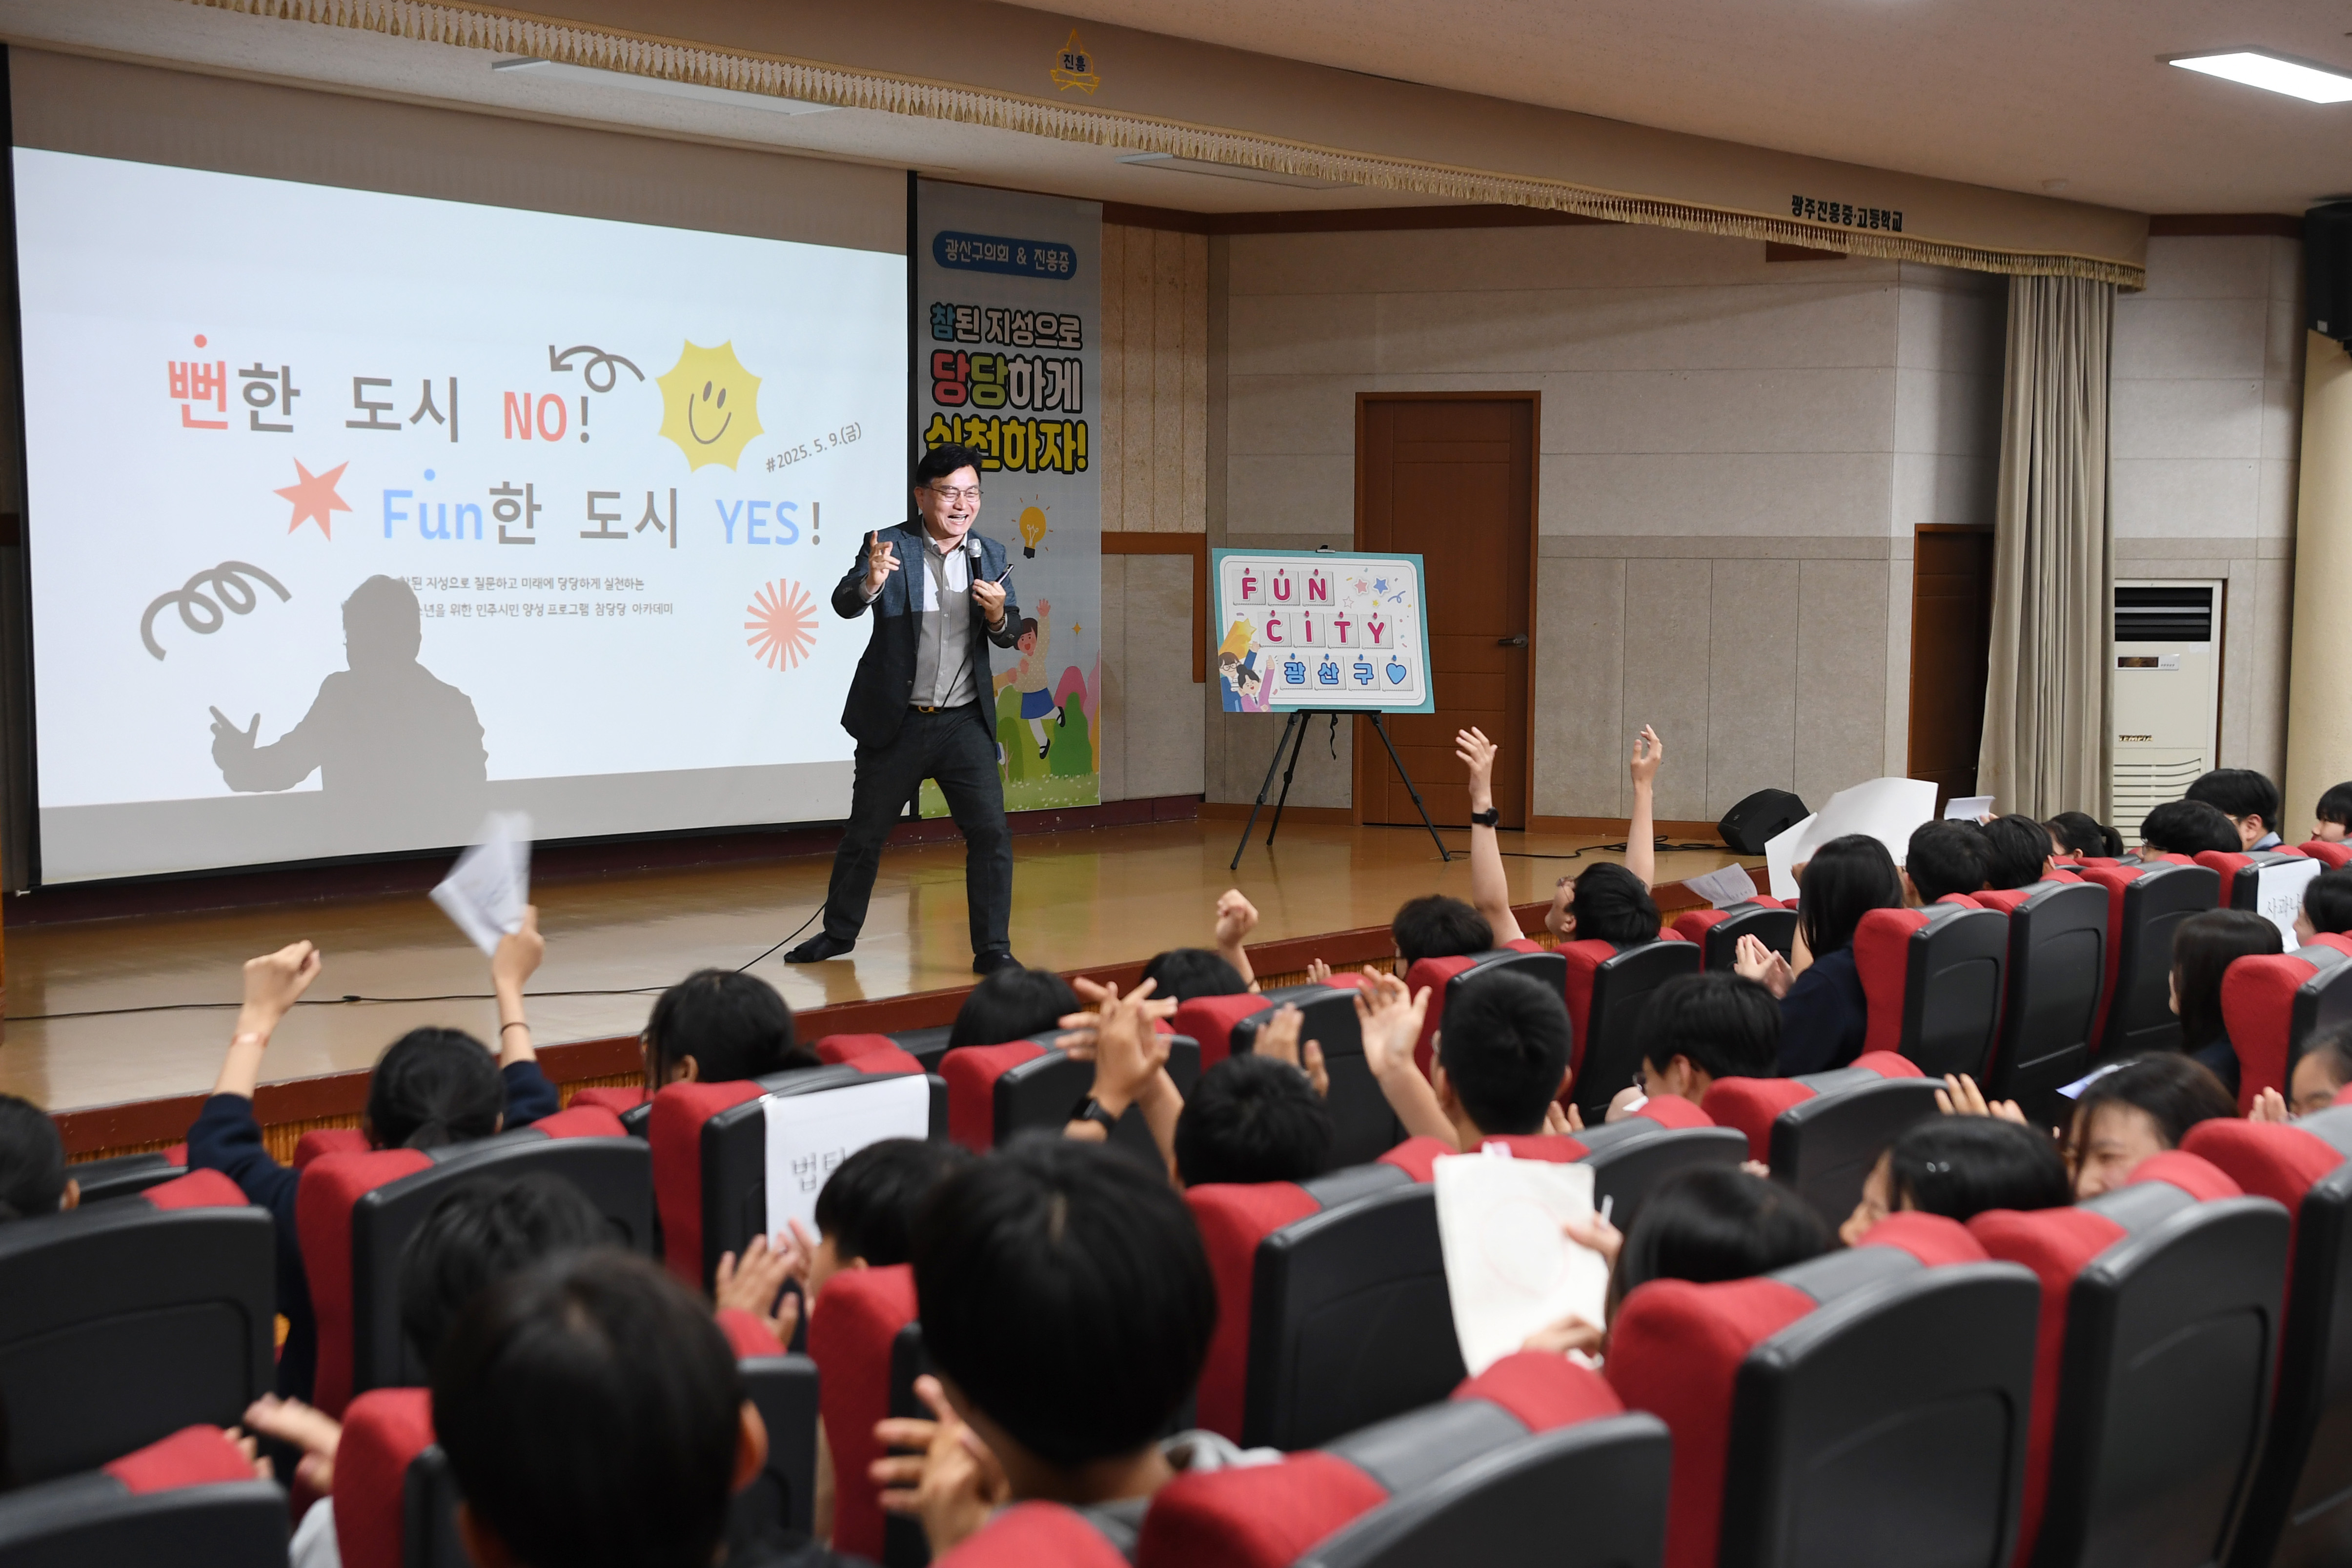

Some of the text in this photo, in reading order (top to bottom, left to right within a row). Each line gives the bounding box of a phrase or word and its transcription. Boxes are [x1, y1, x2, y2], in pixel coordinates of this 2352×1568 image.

[1064, 54, 1085, 72] 진흥
[945, 238, 1070, 273] 광산구의회 & 진흥중
[930, 302, 1083, 350] 참된 지성으로
[931, 349, 1083, 413] 당당하게
[168, 361, 590, 443] 뻔한 도시 NO!
[766, 422, 861, 473] #2025. 5. 9.(금)
[383, 482, 821, 549] Fun한 도시 YES!
[426, 576, 470, 591] 지성으로
[474, 576, 518, 591] 질문하고
[521, 577, 554, 590] 미래에
[557, 577, 601, 591] 당당하게
[604, 577, 645, 591] 실천하는
[1241, 577, 1327, 601] FUN
[421, 602, 673, 617] 년을 위한 민주시민 양성 프로그램 참당당 아카데미
[1266, 619, 1385, 644] CITY
[1284, 661, 1374, 685] 광산구
